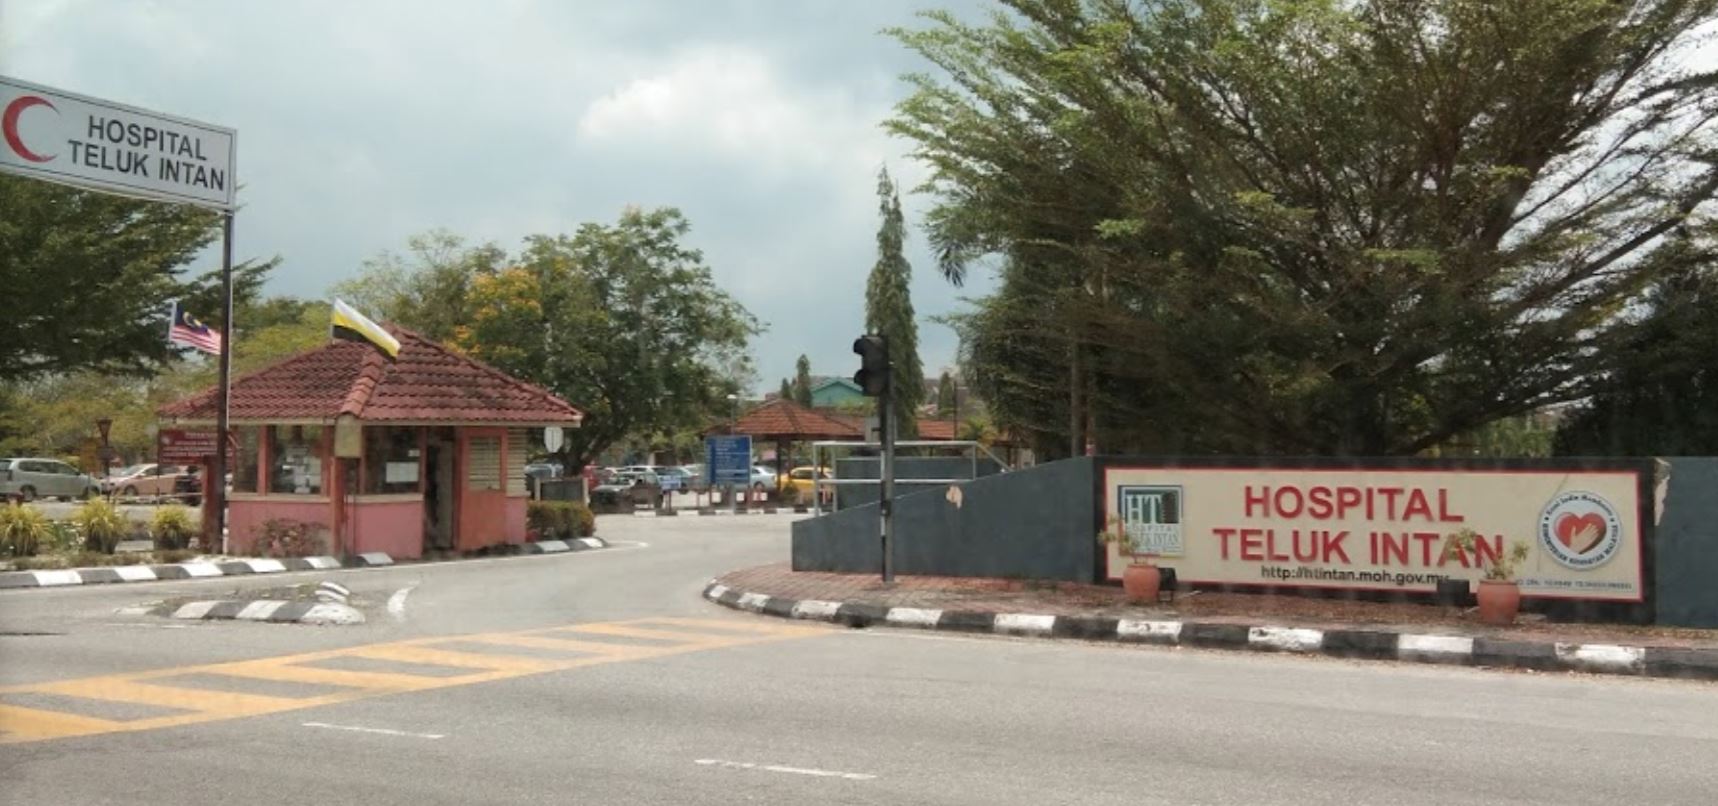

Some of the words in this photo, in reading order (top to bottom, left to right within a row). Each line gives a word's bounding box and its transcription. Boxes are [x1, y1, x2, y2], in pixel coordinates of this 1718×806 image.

[88, 115, 207, 160] HOSPITAL
[67, 139, 149, 177] TELUK
[159, 157, 224, 191] INTAN
[1245, 486, 1464, 522] HOSPITAL
[1213, 529, 1350, 564] TELUK
[1370, 532, 1503, 568] INTAN
